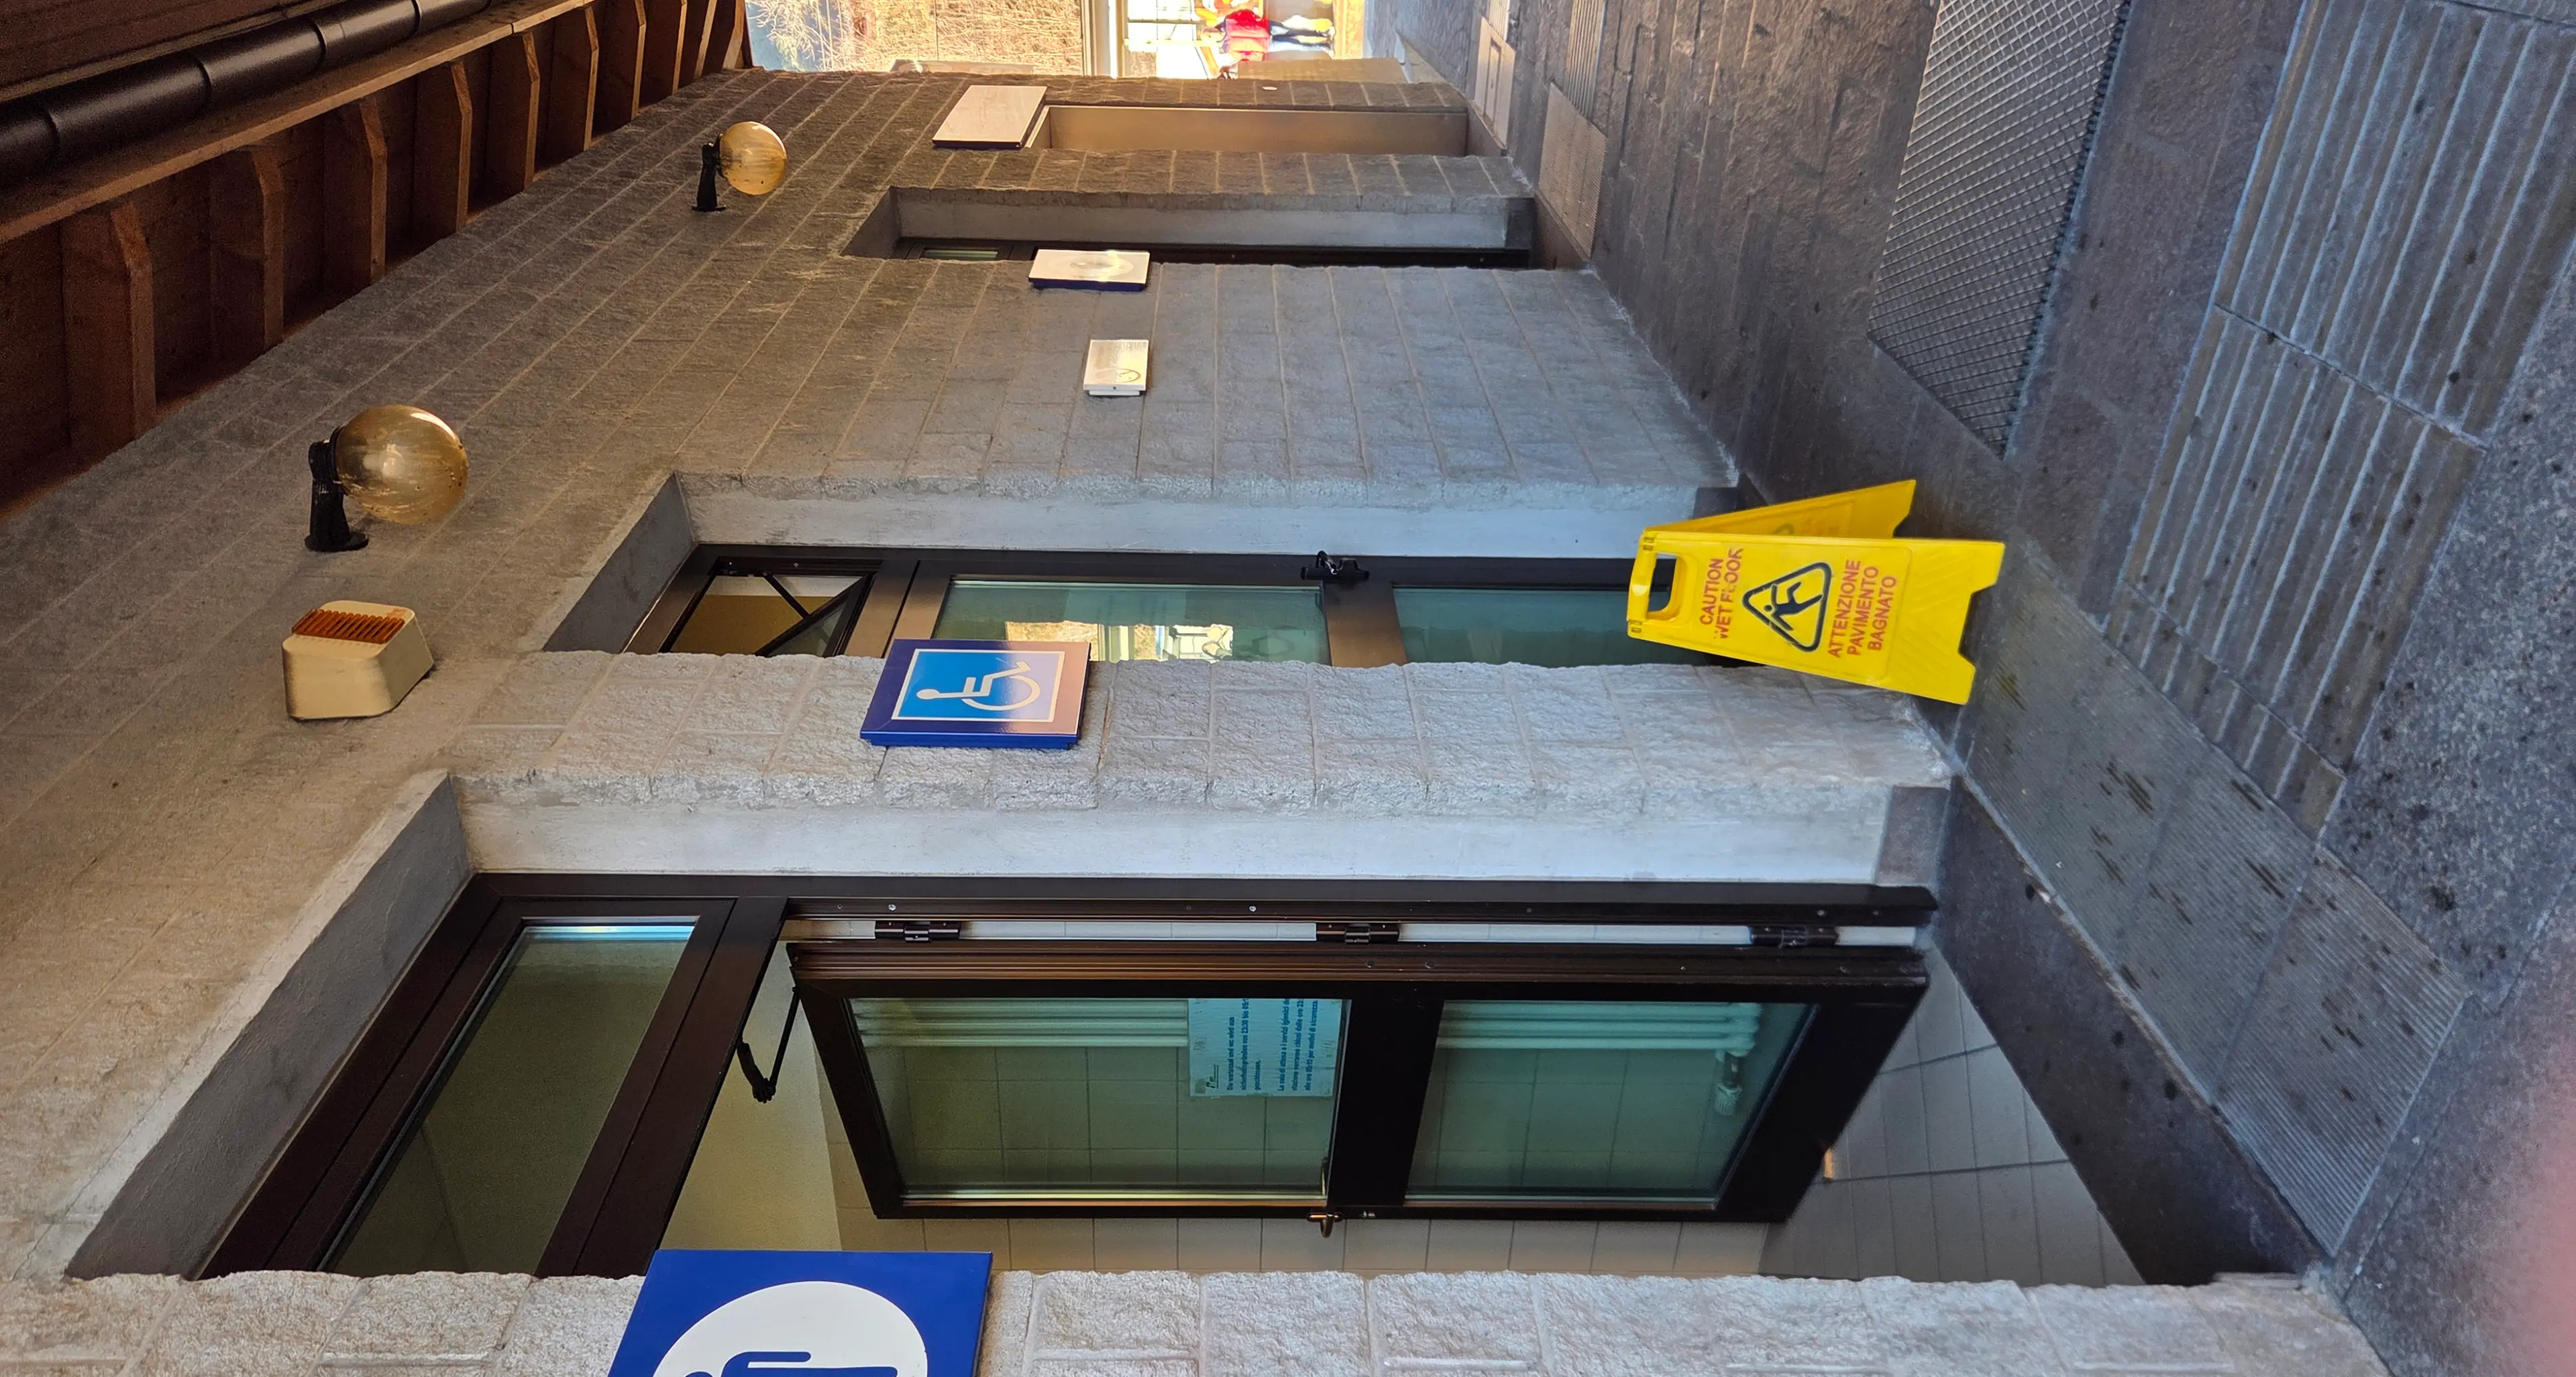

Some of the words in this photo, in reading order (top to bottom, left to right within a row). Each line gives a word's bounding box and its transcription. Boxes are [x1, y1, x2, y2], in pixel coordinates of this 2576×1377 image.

[1699, 558, 1723, 625] CAUTION
[1713, 606, 1733, 639] WET
[1827, 559, 1861, 658] ATTENZIONE
[1846, 565, 1879, 656] PAVIMENTO
[1867, 575, 1897, 651] BAGNATO
